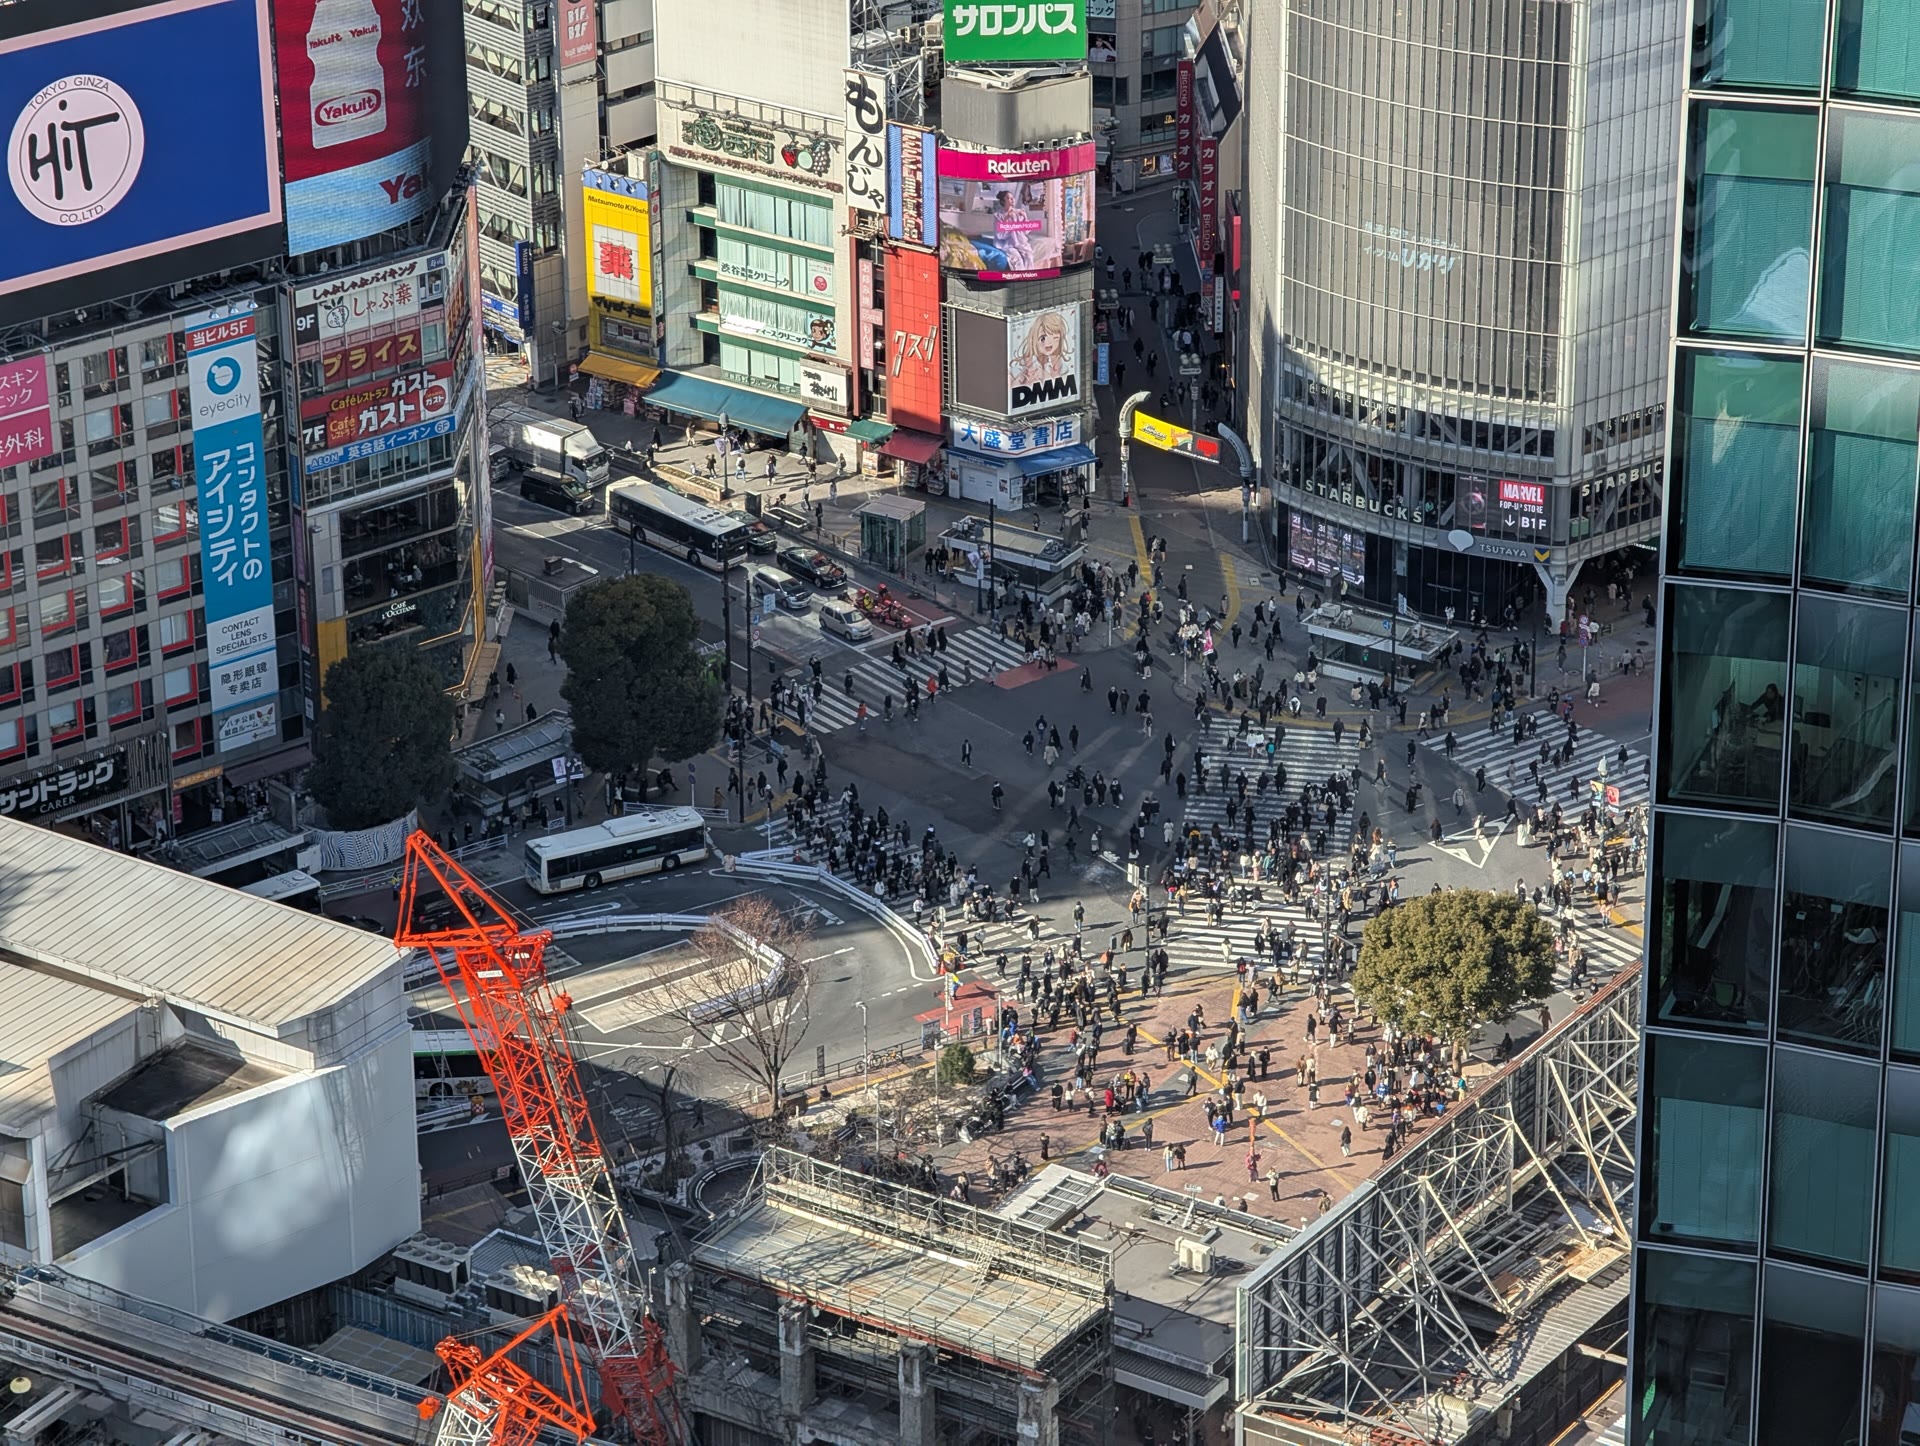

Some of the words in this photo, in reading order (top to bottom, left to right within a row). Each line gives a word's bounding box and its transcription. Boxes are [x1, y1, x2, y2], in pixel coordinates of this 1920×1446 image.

[953, 3, 1077, 36] サロンパス
[309, 32, 343, 49] Yakult
[349, 24, 379, 38] Yakult
[28, 80, 67, 111] TOKYO
[74, 76, 110, 93] GINZA
[323, 96, 375, 120] Yakult
[846, 73, 885, 210] もんじゃ
[1179, 114, 1191, 171] カラオケ
[988, 158, 1050, 174] Rakuten
[1202, 148, 1215, 207] カラオケ
[588, 195, 624, 210] Matsumoto
[1000, 222, 1022, 230] Rakuten
[600, 241, 633, 281] 薬
[1023, 271, 1038, 279] Vision
[353, 283, 412, 317] しゃぶ葉
[193, 320, 248, 347] 当ビル5F
[296, 314, 315, 331] 9F
[323, 334, 417, 377] プライス
[893, 326, 938, 377] クスリ
[391, 371, 437, 399] ガスト
[1012, 374, 1077, 409] DMM
[200, 394, 251, 418] eyecity
[425, 394, 446, 406] ガスト
[329, 416, 355, 432] Café
[358, 401, 415, 435] ガスト
[0, 427, 45, 458] 外科
[303, 424, 326, 445] 7F
[310, 453, 339, 469] AEON
[348, 426, 432, 460] 英会話イーオン
[436, 422, 450, 433] 6F
[961, 421, 1072, 450] 大盛堂書店
[1503, 483, 1543, 503] MARVEL
[1582, 461, 1662, 497] STARBUC
[236, 441, 262, 580] コンタクトの
[1305, 479, 1423, 523] STARBUCKS
[203, 450, 237, 586] アイシティ
[1521, 516, 1547, 530] B1F
[1480, 544, 1527, 557] TSUTAYA
[221, 617, 260, 634] CONTACT
[230, 629, 252, 641] LENS
[216, 633, 268, 655] SPECIALISTS
[220, 661, 268, 686] 隐形眼镜
[228, 678, 262, 695] 专卖店
[0, 757, 115, 814] サンドラッグ
